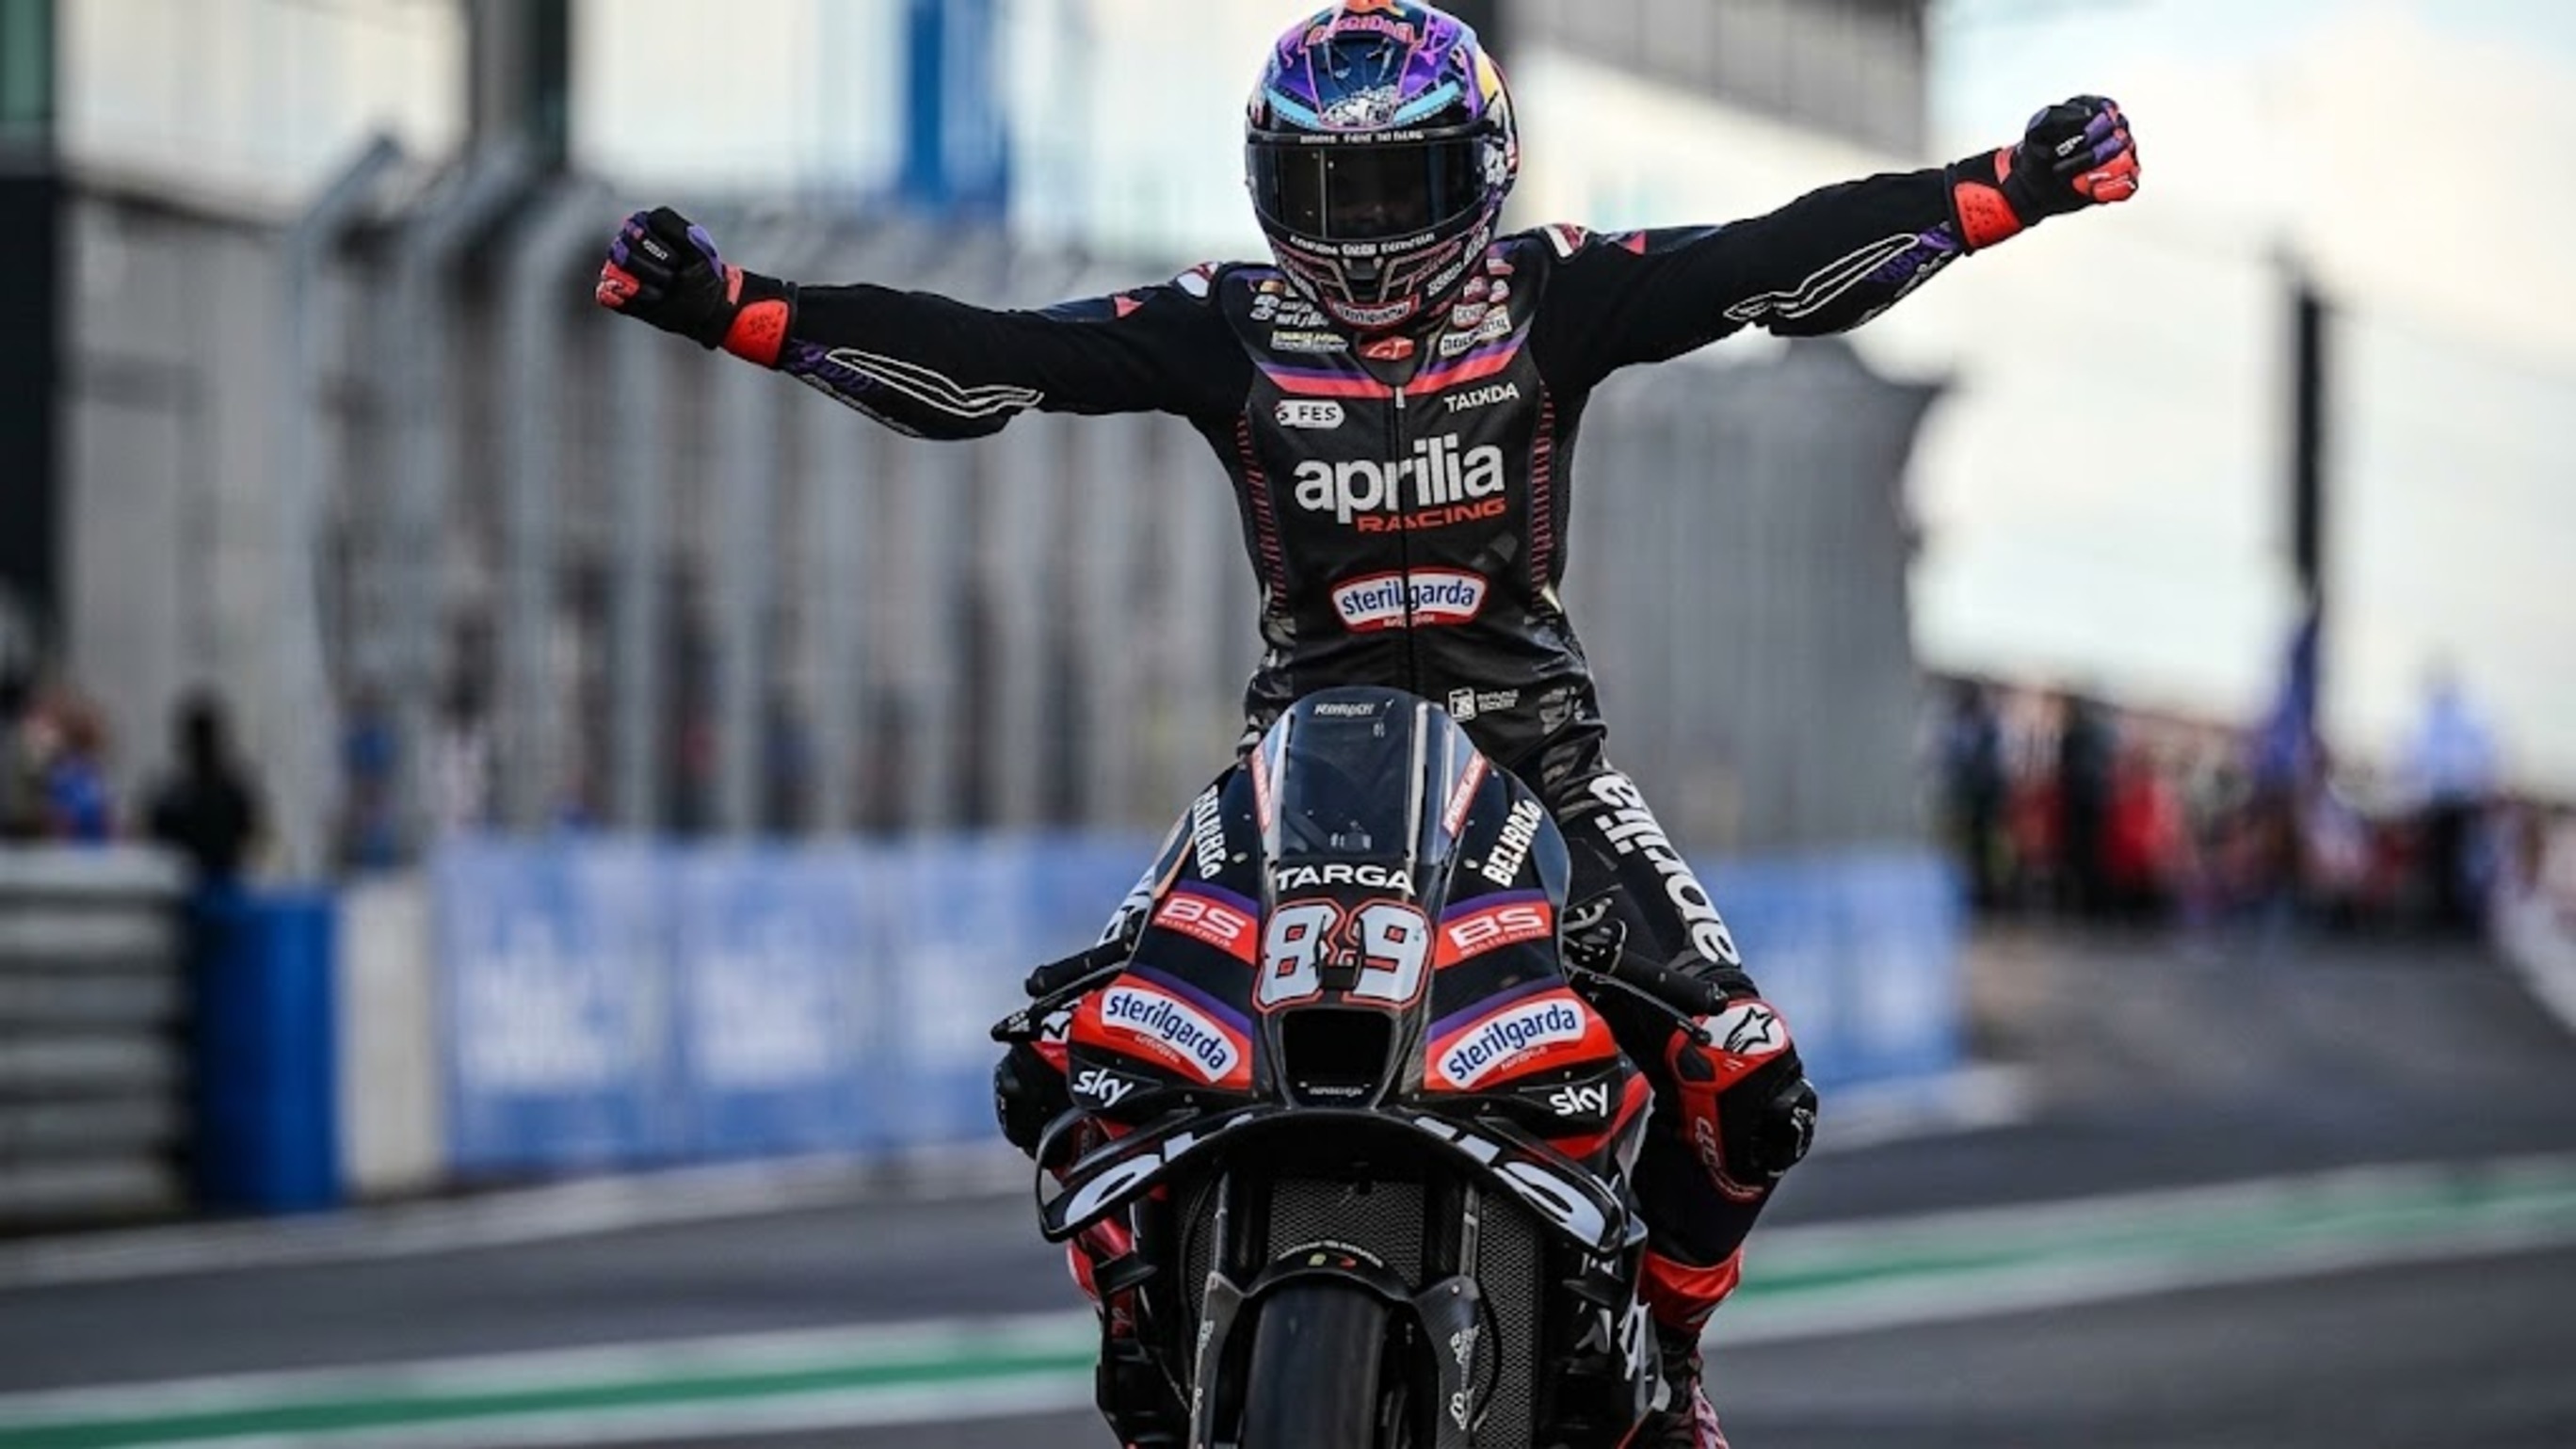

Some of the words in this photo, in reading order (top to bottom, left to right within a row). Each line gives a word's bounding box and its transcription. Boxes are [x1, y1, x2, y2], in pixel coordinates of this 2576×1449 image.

[1294, 433, 1505, 523] aprilia
[1357, 497, 1506, 533] RACING
[1342, 577, 1475, 616] sterilgarda
[1277, 864, 1416, 895] TARGA
[1161, 897, 1247, 940] BS
[1448, 907, 1544, 949] BS
[1253, 898, 1434, 1013] 89
[1106, 991, 1228, 1071] sterilgarda
[1448, 1000, 1578, 1081] sterilgarda
[1072, 1068, 1134, 1107] sky
[1549, 1083, 1609, 1118] sky
